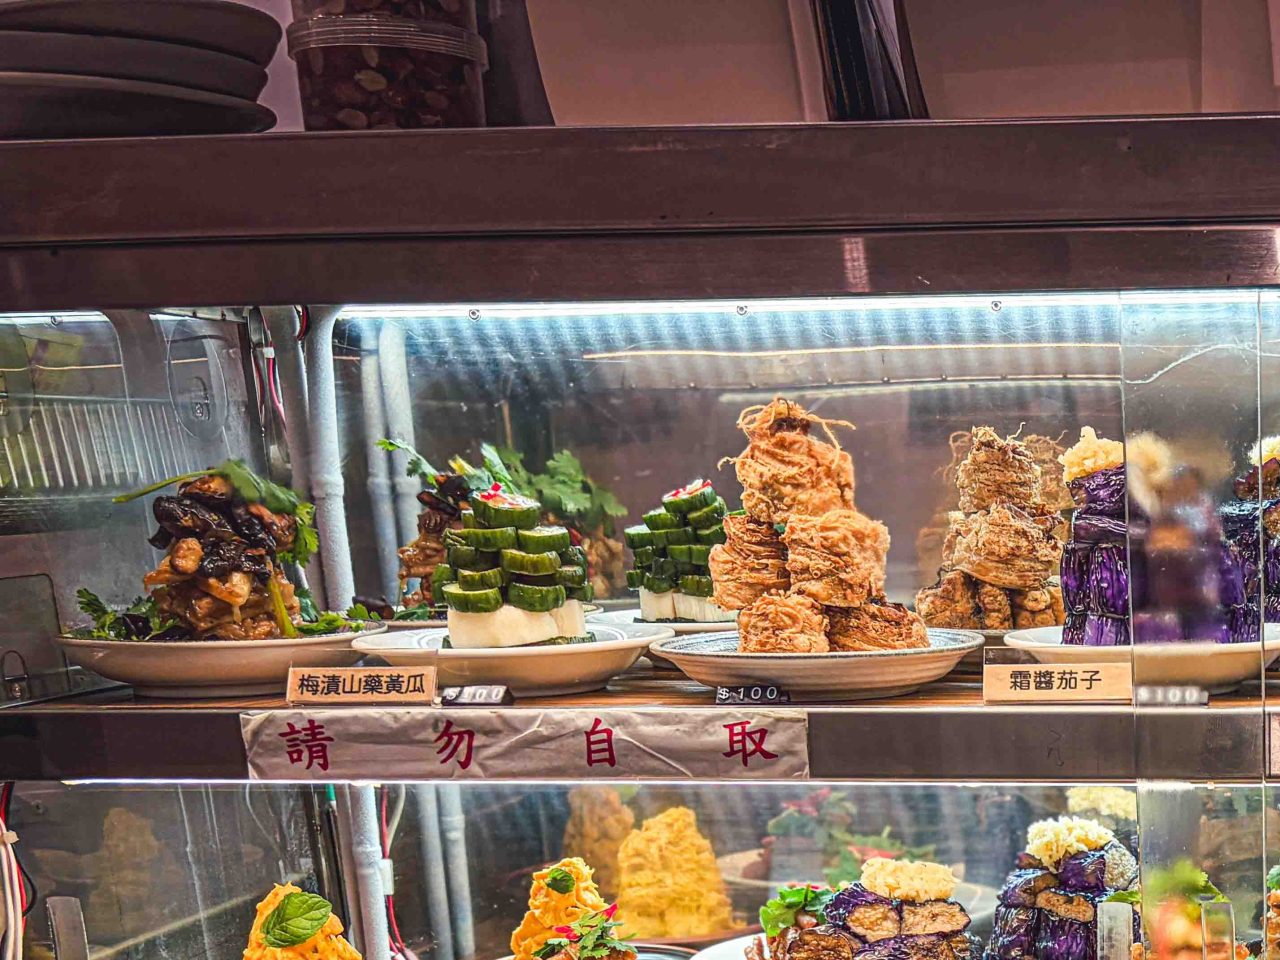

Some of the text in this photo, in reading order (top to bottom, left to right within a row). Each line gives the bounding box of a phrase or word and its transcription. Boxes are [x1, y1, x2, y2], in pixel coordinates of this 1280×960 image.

[298, 673, 425, 695] 梅漬山藥黃瓜
[1009, 670, 1102, 691] 霜醬茄子
[718, 686, 779, 700] $100
